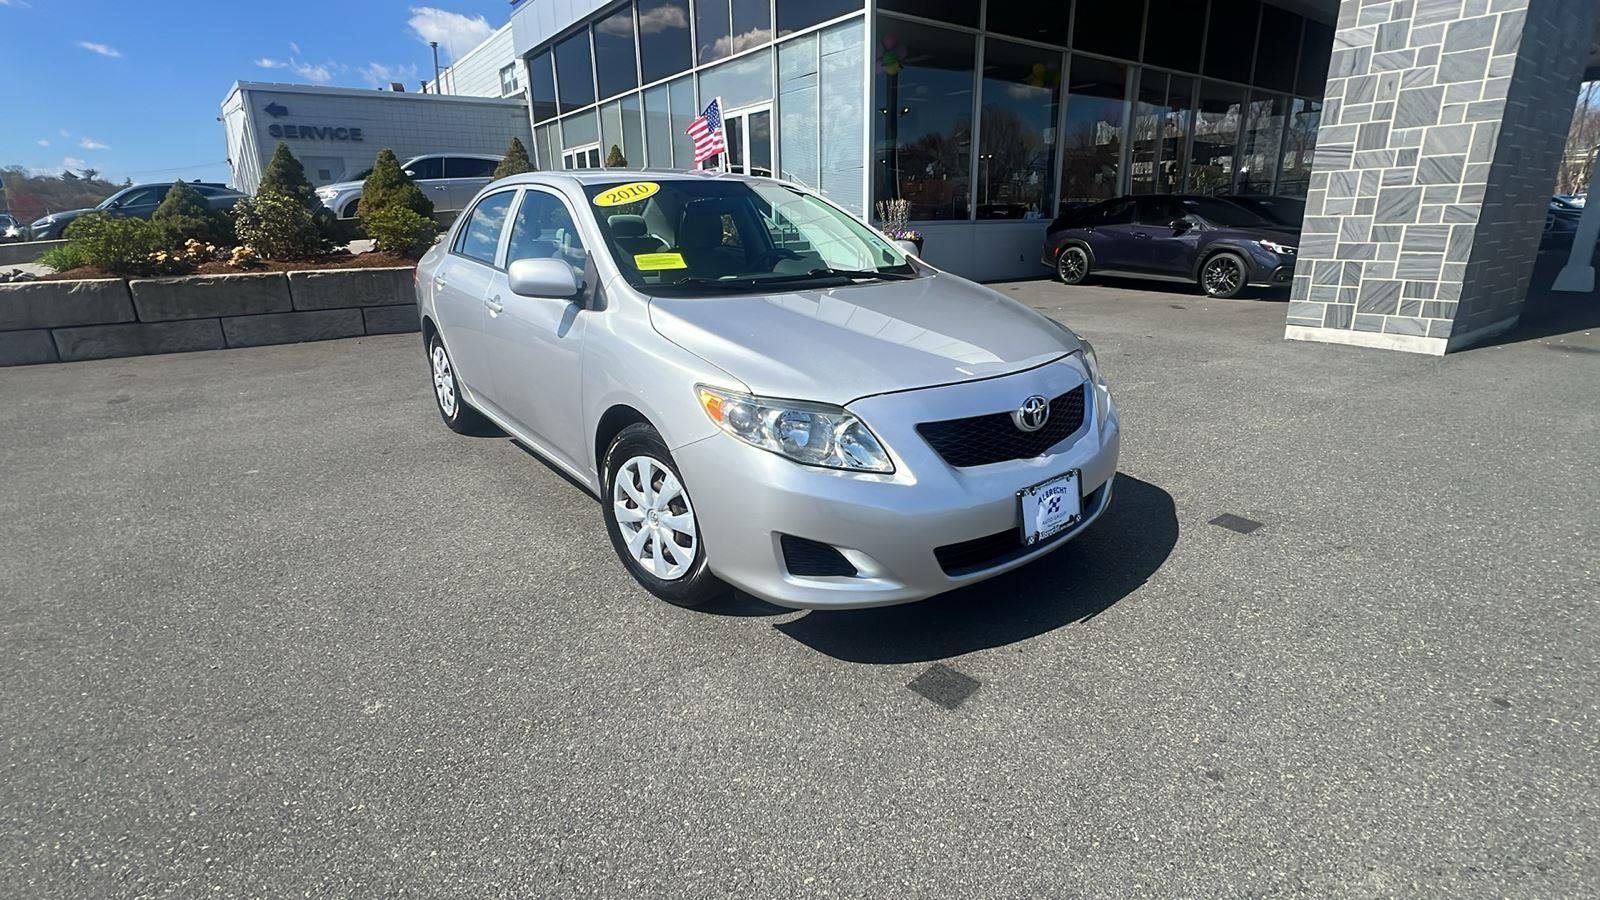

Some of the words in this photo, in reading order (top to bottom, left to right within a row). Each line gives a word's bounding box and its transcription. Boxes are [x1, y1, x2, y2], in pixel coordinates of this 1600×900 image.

[268, 124, 364, 141] SERVICE
[606, 184, 649, 204] 2010
[1038, 487, 1067, 505] ALBRECHT
